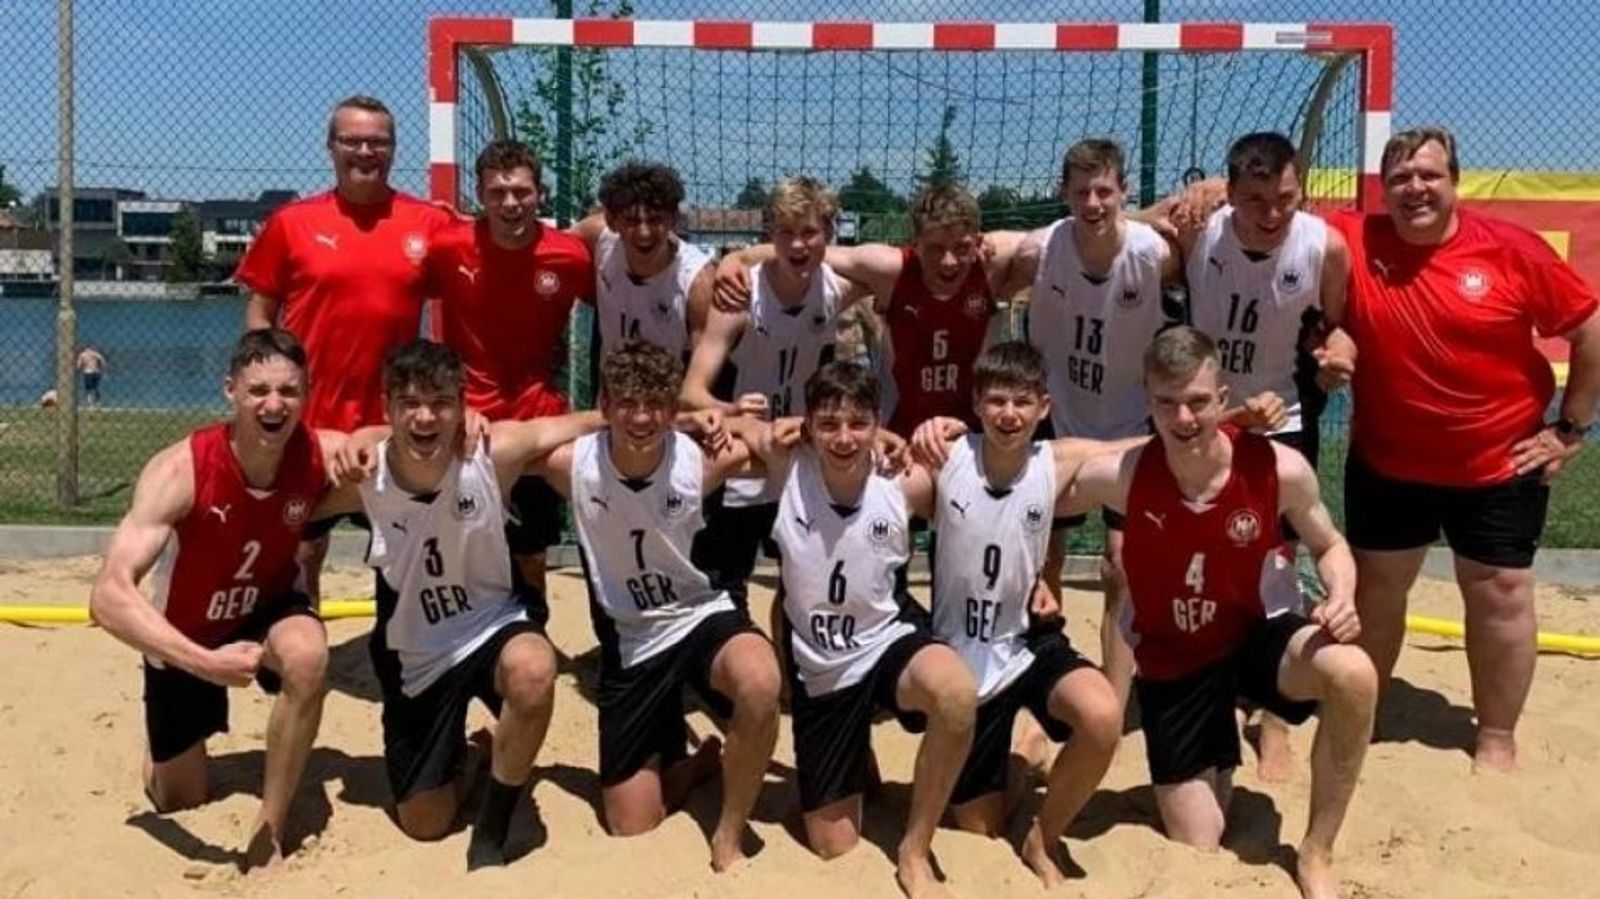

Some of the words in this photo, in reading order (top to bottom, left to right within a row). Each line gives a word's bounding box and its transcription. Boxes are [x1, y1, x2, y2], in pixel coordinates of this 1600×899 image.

[1227, 293, 1258, 333] 16
[1075, 315, 1103, 355] 13
[921, 364, 958, 392] GER
[1068, 355, 1104, 394] GER
[233, 540, 261, 579] 2
[423, 537, 443, 577] 3
[630, 529, 645, 570] 7
[983, 544, 1001, 590] 9
[627, 573, 678, 610] GER
[828, 560, 846, 605] 6
[1185, 552, 1205, 594] 4
[206, 586, 259, 620] GER
[420, 585, 472, 625] GER
[1172, 598, 1217, 633] GER
[811, 614, 860, 651] GER
